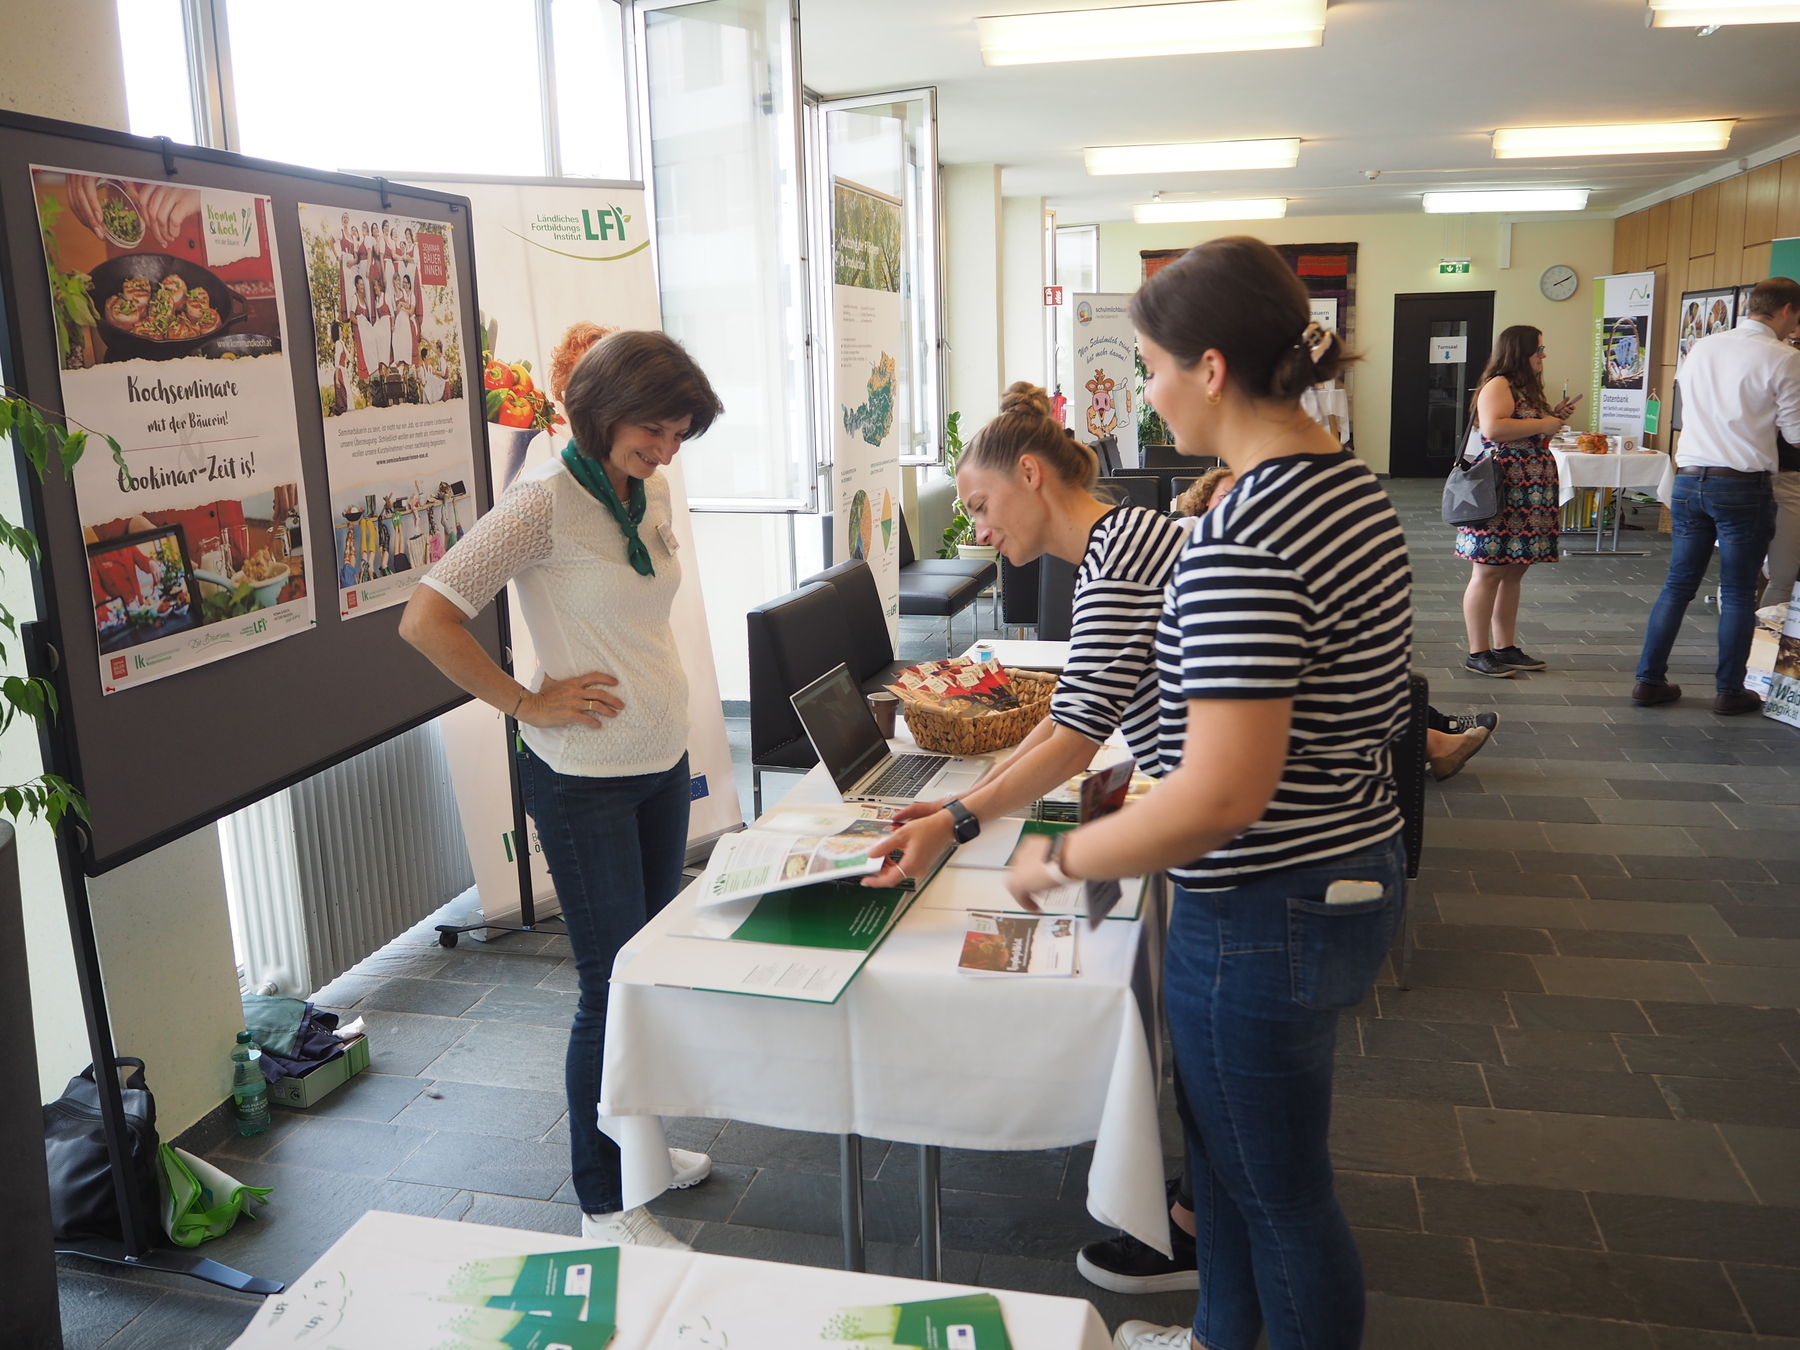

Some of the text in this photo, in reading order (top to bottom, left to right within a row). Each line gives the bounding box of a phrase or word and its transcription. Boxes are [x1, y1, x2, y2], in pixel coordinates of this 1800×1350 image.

[207, 204, 237, 223] Komm
[537, 214, 579, 223] Ländliches
[581, 202, 625, 241] LFI
[531, 223, 580, 233] Fortbildungs
[553, 233, 582, 241] Institut
[1090, 336, 1118, 348] Schulmilch
[127, 375, 239, 404] Kochseminare
[147, 410, 229, 434] mit der Bäuerin!
[116, 451, 256, 493] Cookinar-Zeit is!
